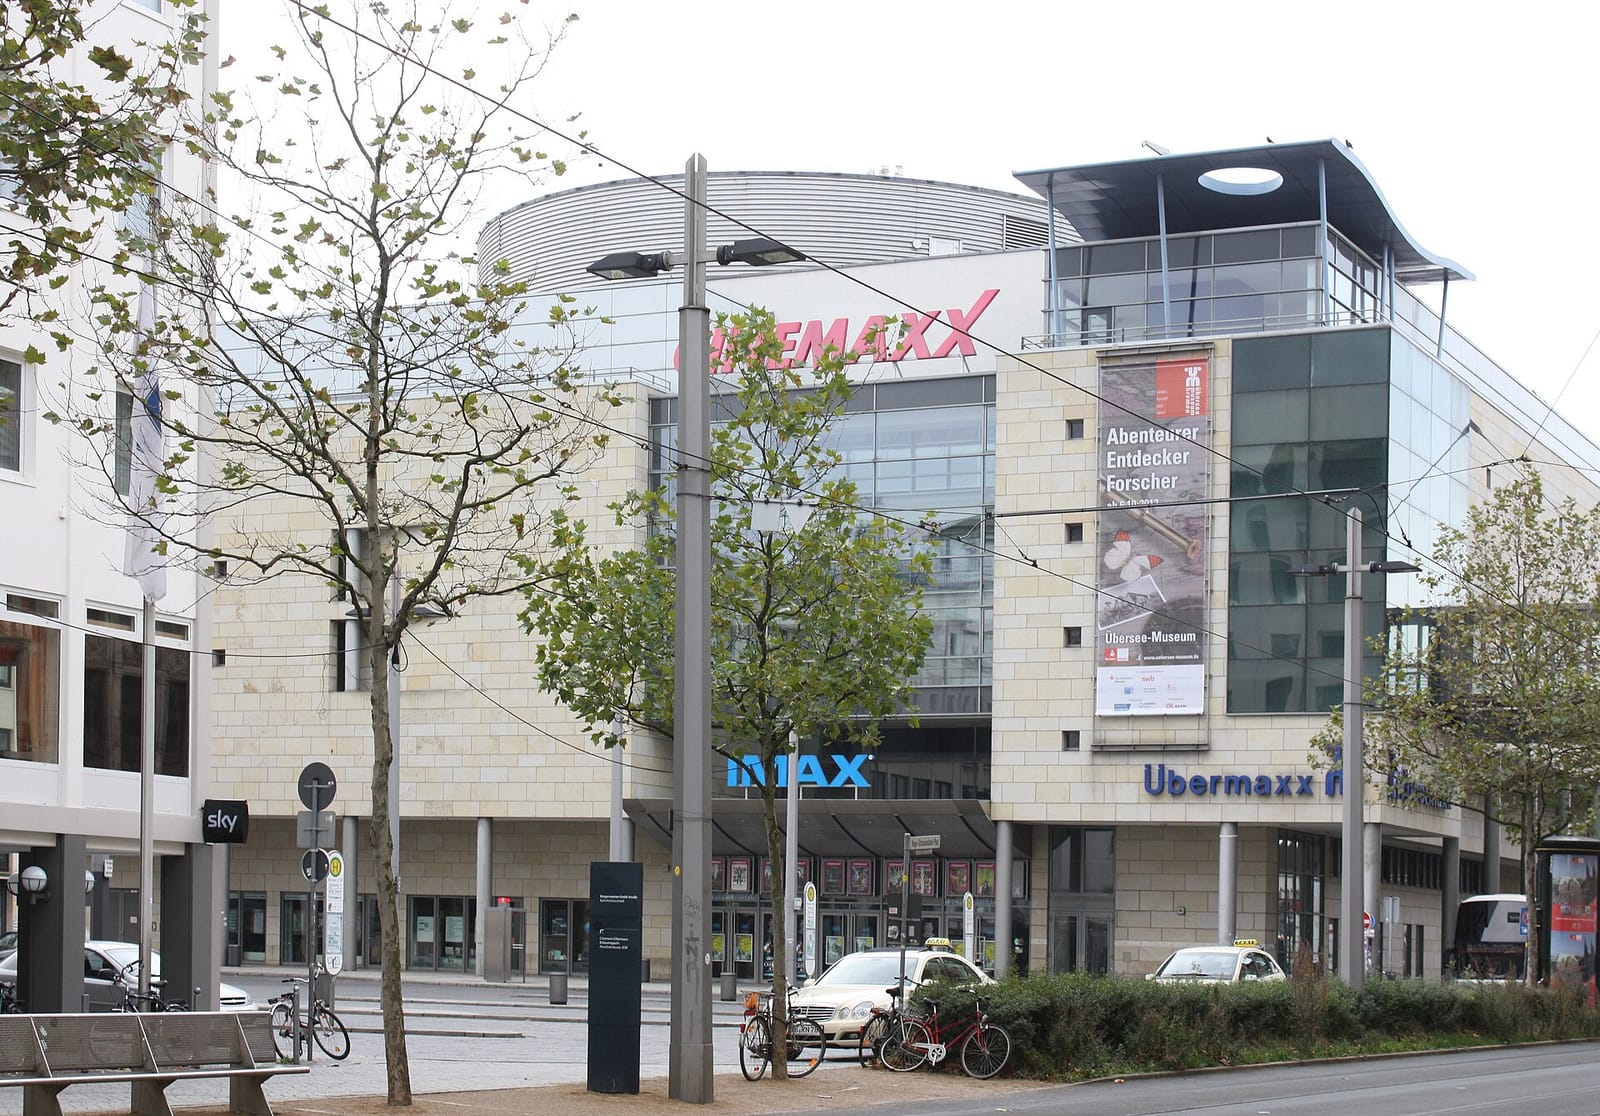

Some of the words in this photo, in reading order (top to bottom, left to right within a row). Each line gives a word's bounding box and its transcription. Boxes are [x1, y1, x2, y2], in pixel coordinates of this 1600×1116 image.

[1106, 426, 1199, 446] Abenteurer
[1106, 448, 1190, 469] Entdecker
[1106, 472, 1179, 493] Forscher
[1105, 630, 1197, 644] Übersee-Museum
[727, 754, 872, 788] IMAX
[1144, 763, 1313, 796] Übermaxx
[207, 809, 238, 833] sky
